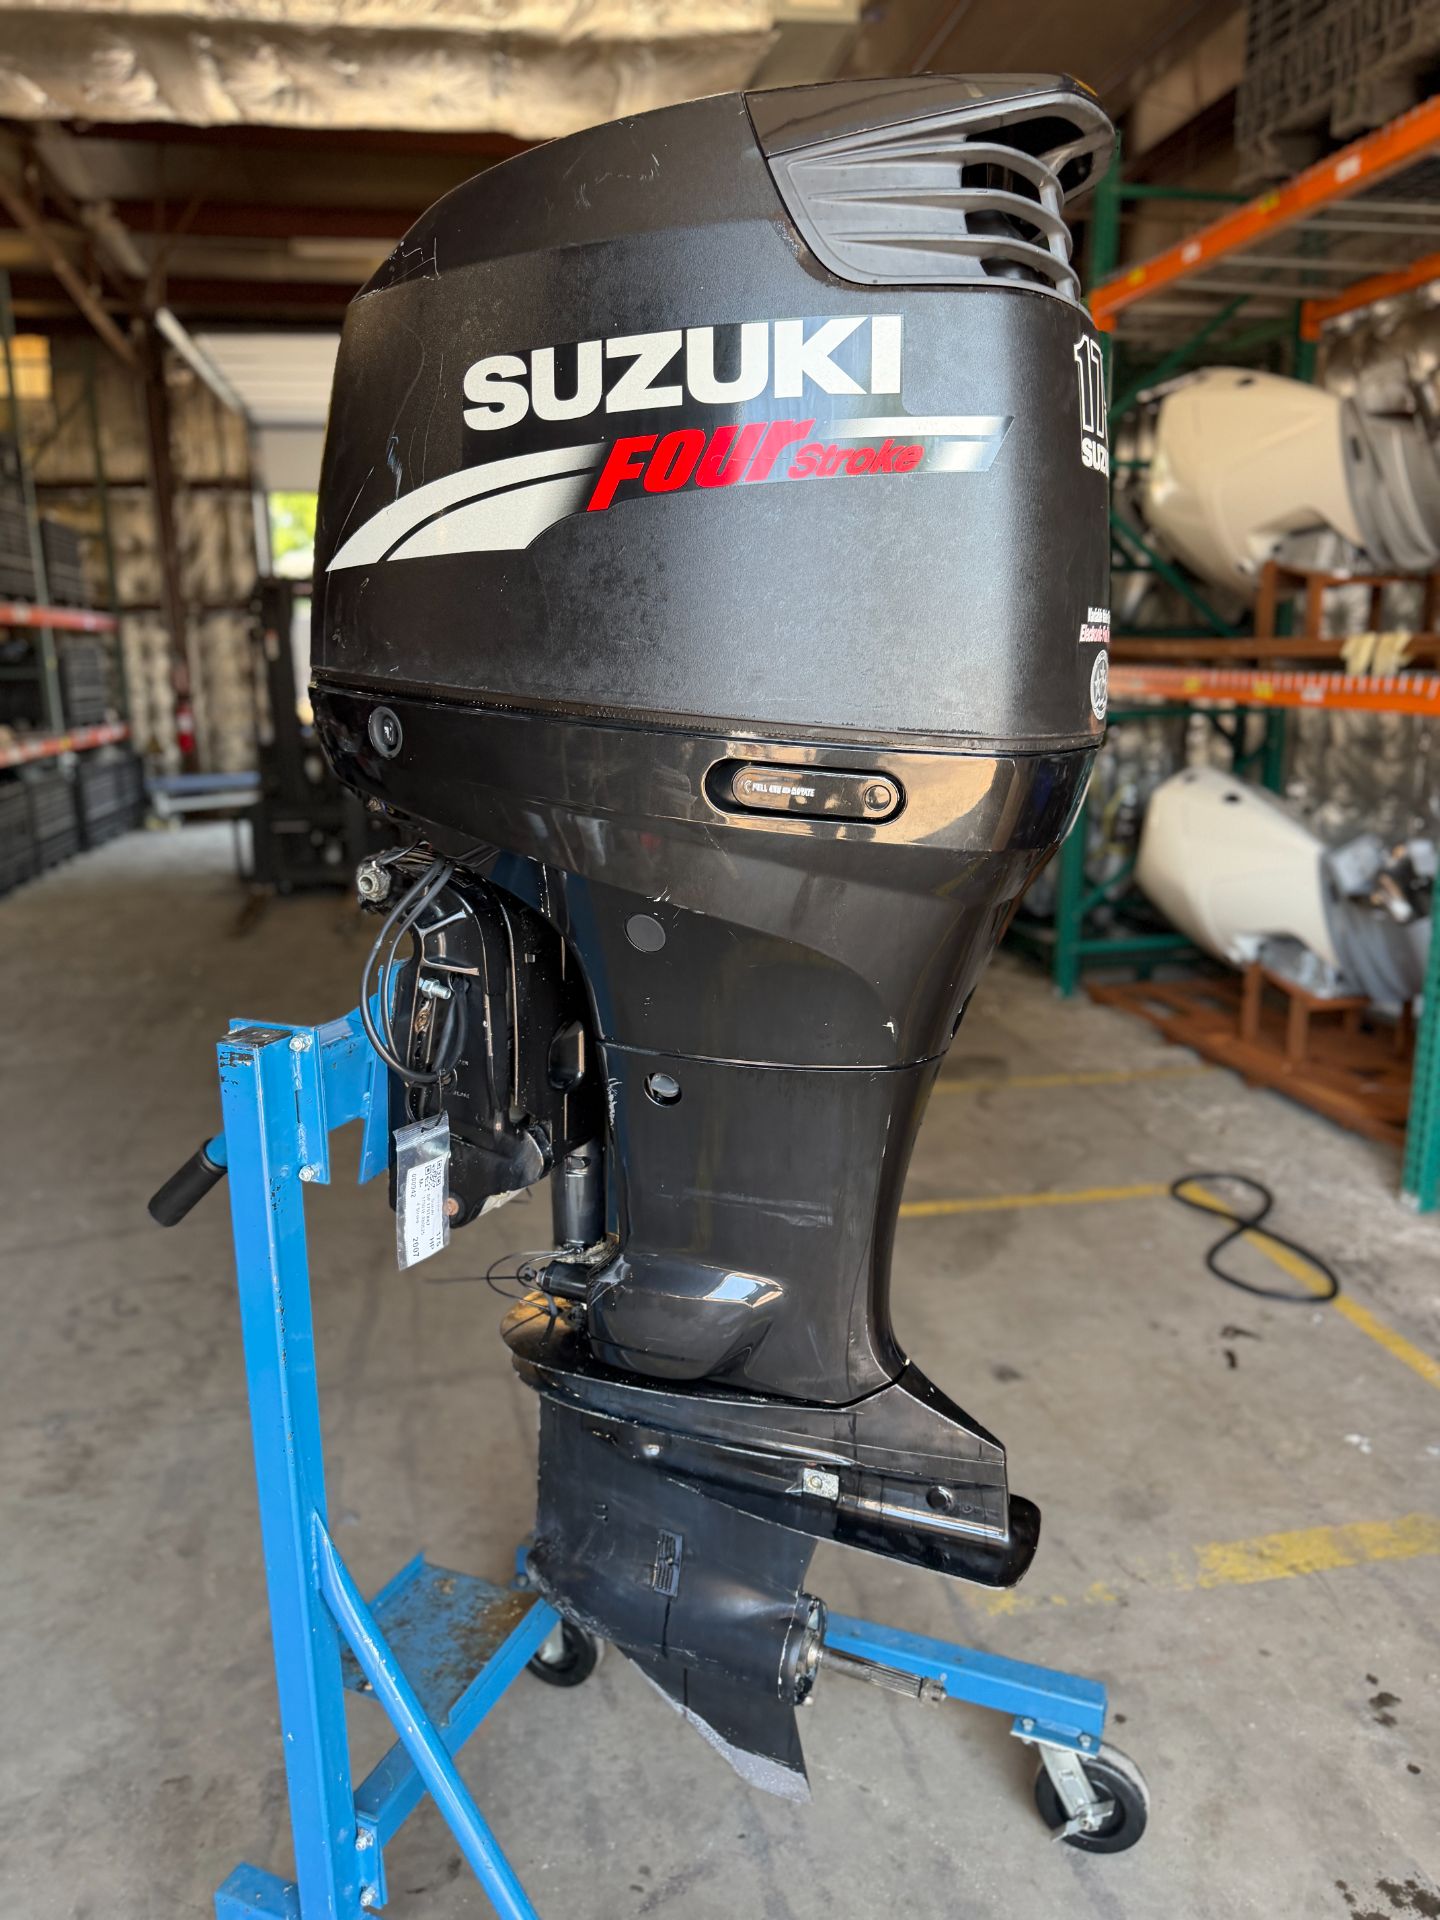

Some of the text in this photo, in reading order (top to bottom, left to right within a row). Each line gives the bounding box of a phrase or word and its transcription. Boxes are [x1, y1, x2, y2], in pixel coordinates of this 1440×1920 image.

[463, 314, 902, 432] SUZUKI
[1073, 334, 1108, 439] 17
[787, 438, 924, 480] Stroke
[412, 1236, 420, 1257] 2007
